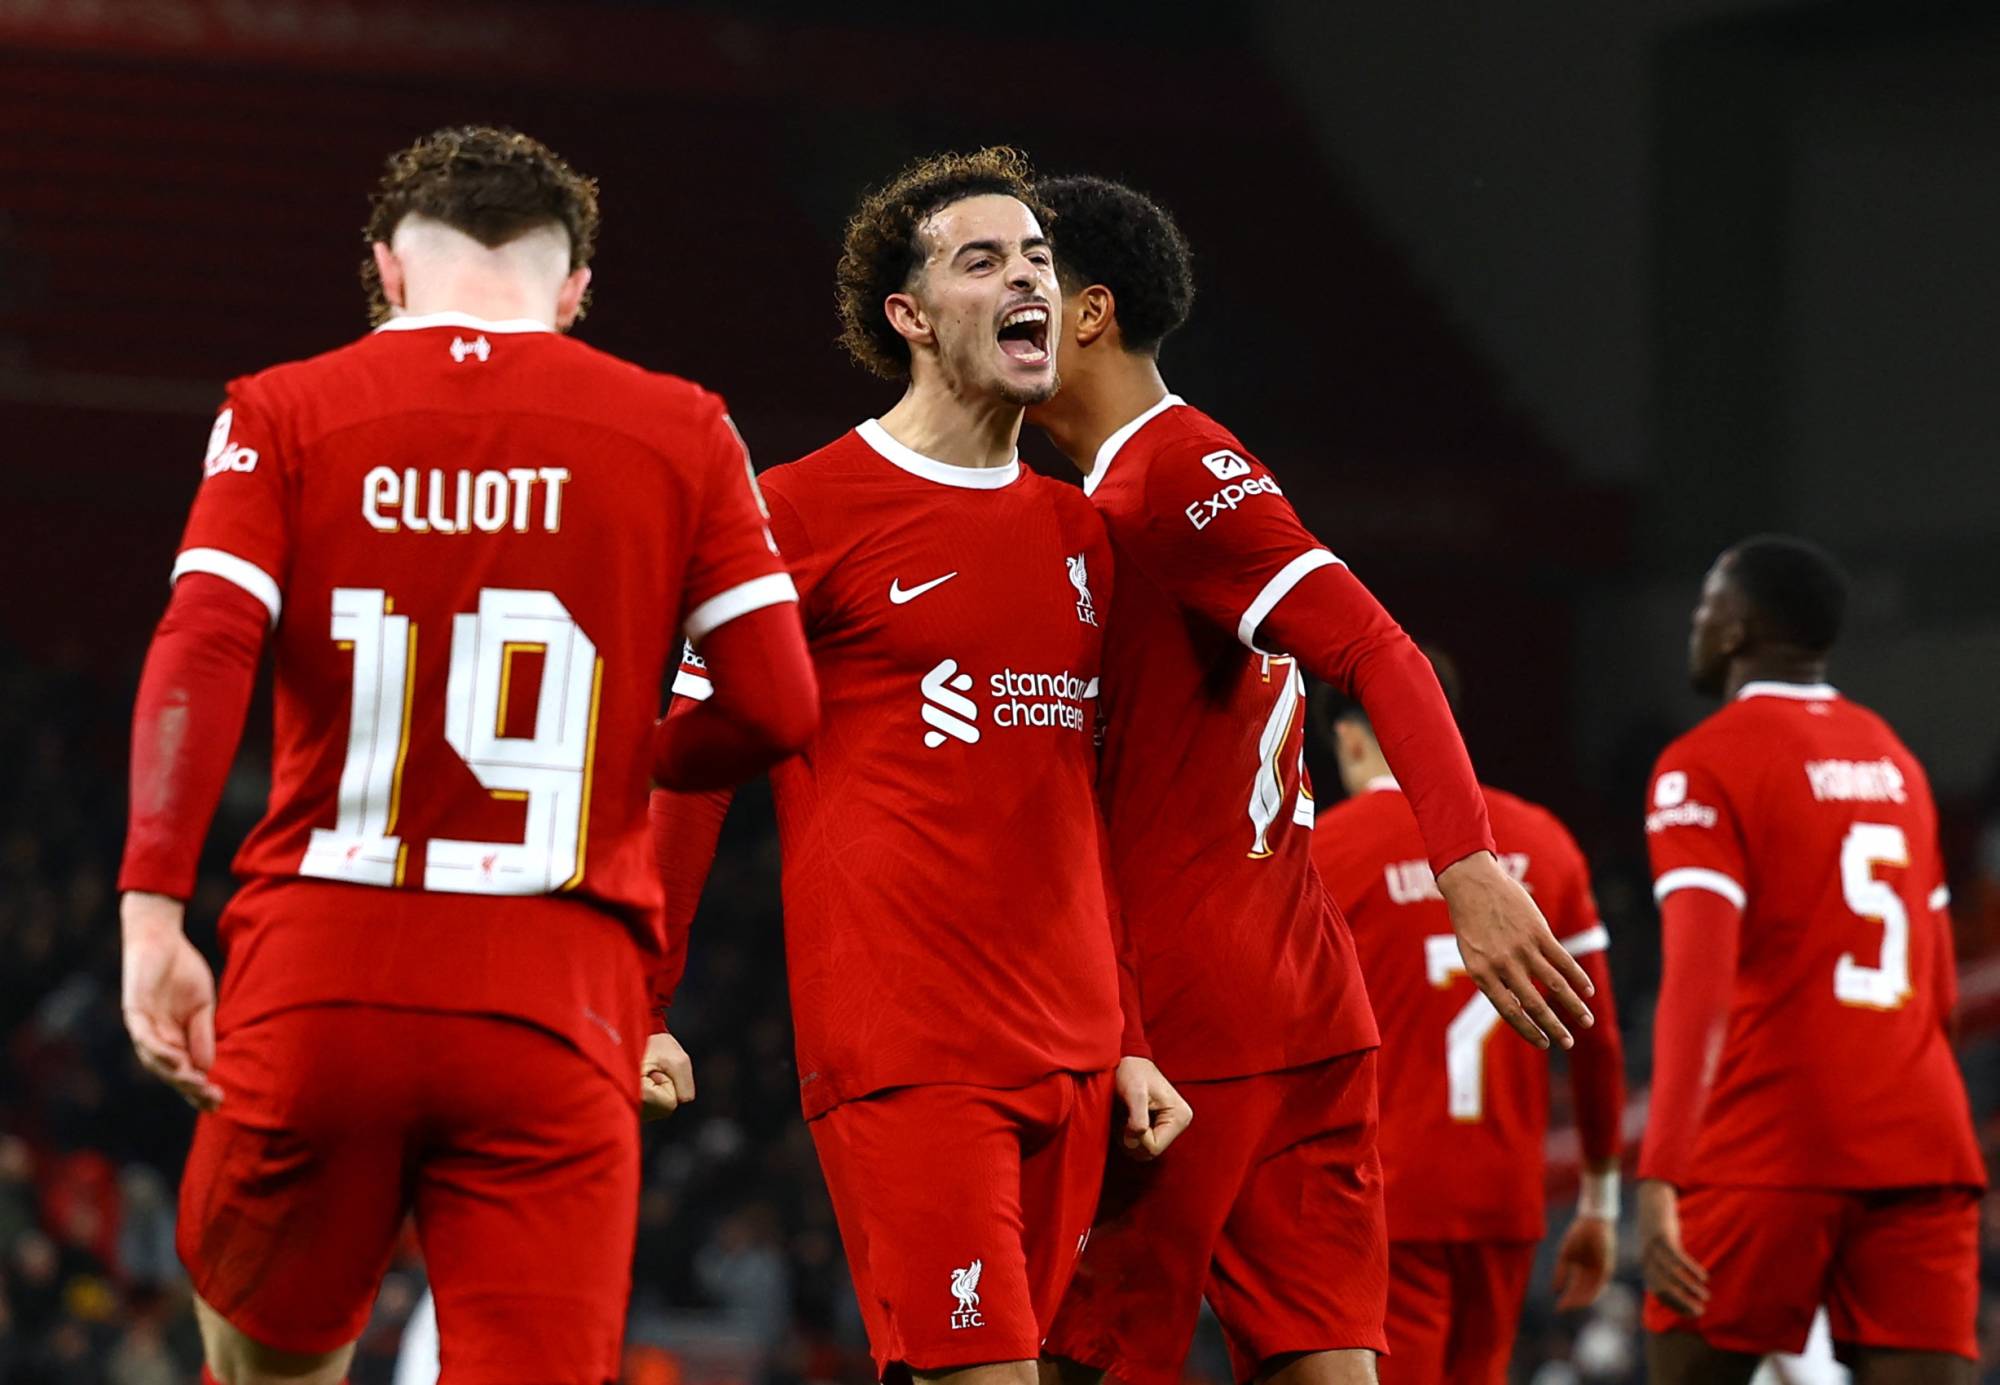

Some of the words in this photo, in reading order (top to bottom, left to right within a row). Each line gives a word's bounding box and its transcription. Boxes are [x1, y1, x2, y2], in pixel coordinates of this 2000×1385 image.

[1185, 474, 1283, 531] Exped
[990, 668, 1086, 702] standar
[300, 588, 605, 896] 19
[993, 698, 1084, 732] chartere
[1834, 822, 1914, 1012] 5
